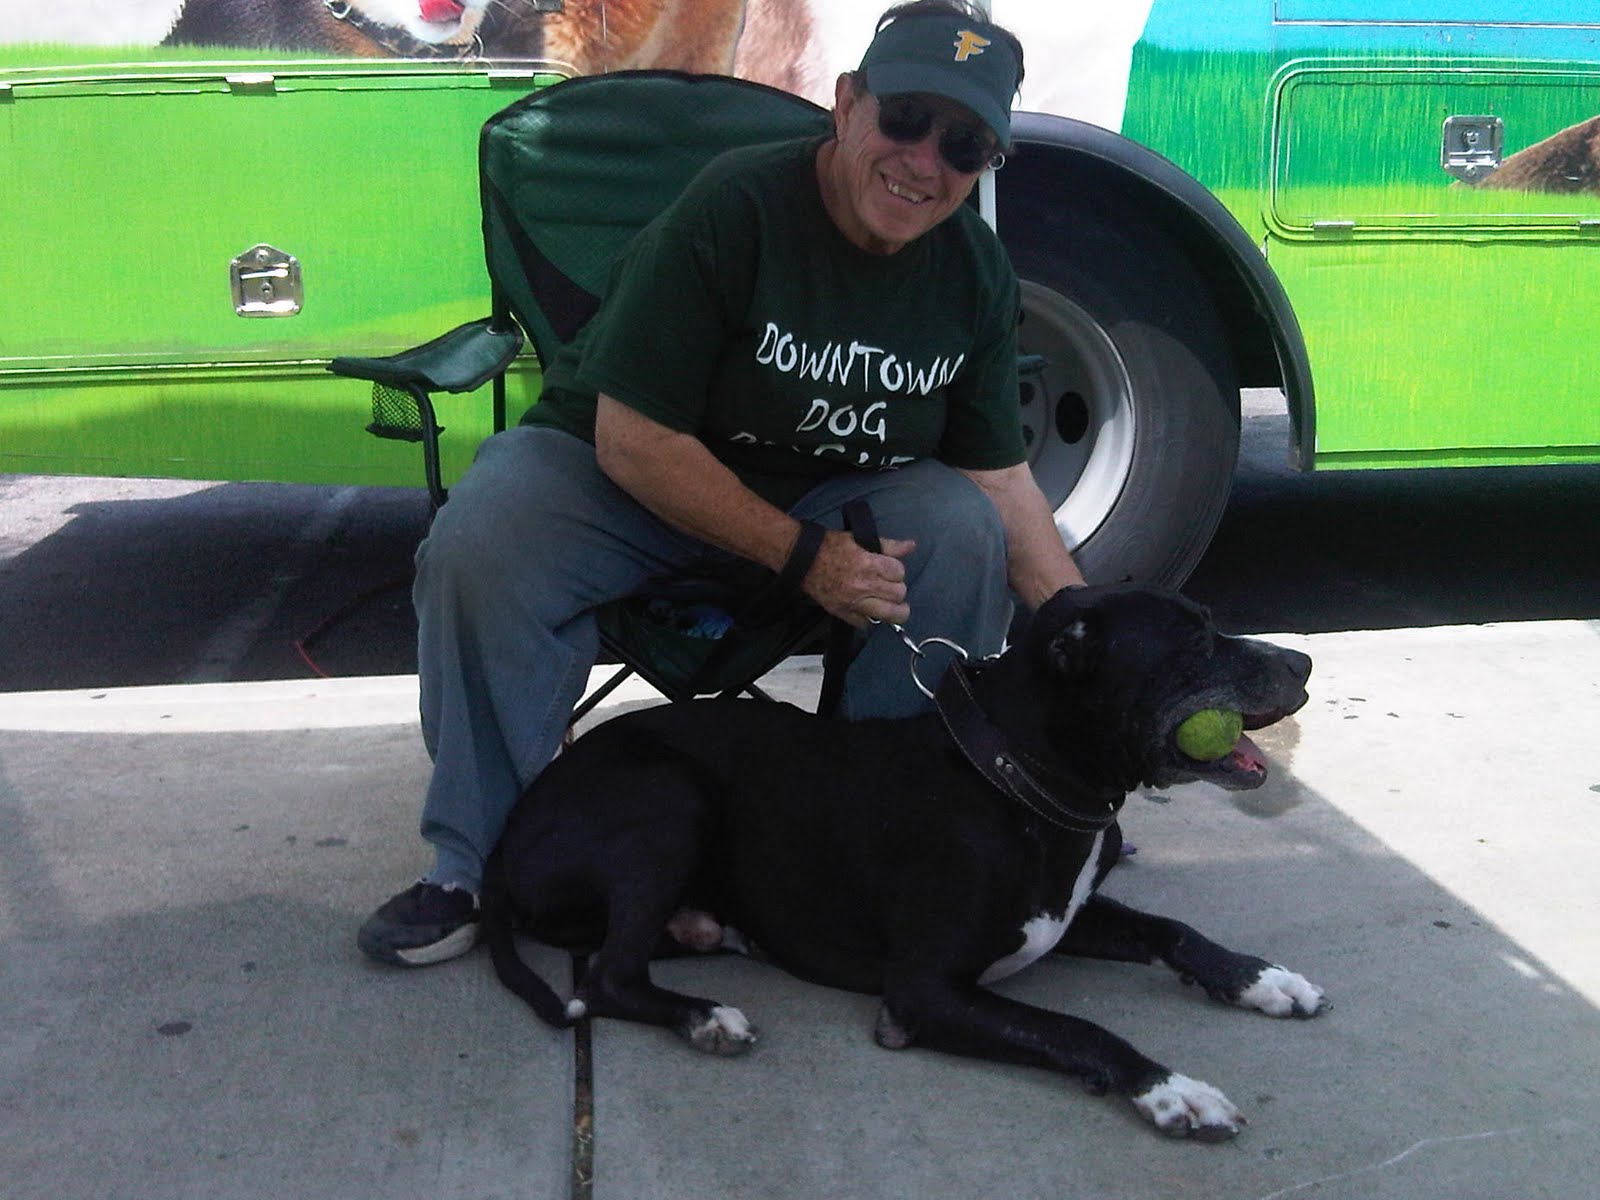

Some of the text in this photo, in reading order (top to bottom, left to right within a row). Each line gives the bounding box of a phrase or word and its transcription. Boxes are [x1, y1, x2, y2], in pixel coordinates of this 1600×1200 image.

[953, 30, 991, 61] F
[756, 322, 964, 396] DOWNTOWN
[796, 398, 887, 443] DOG
